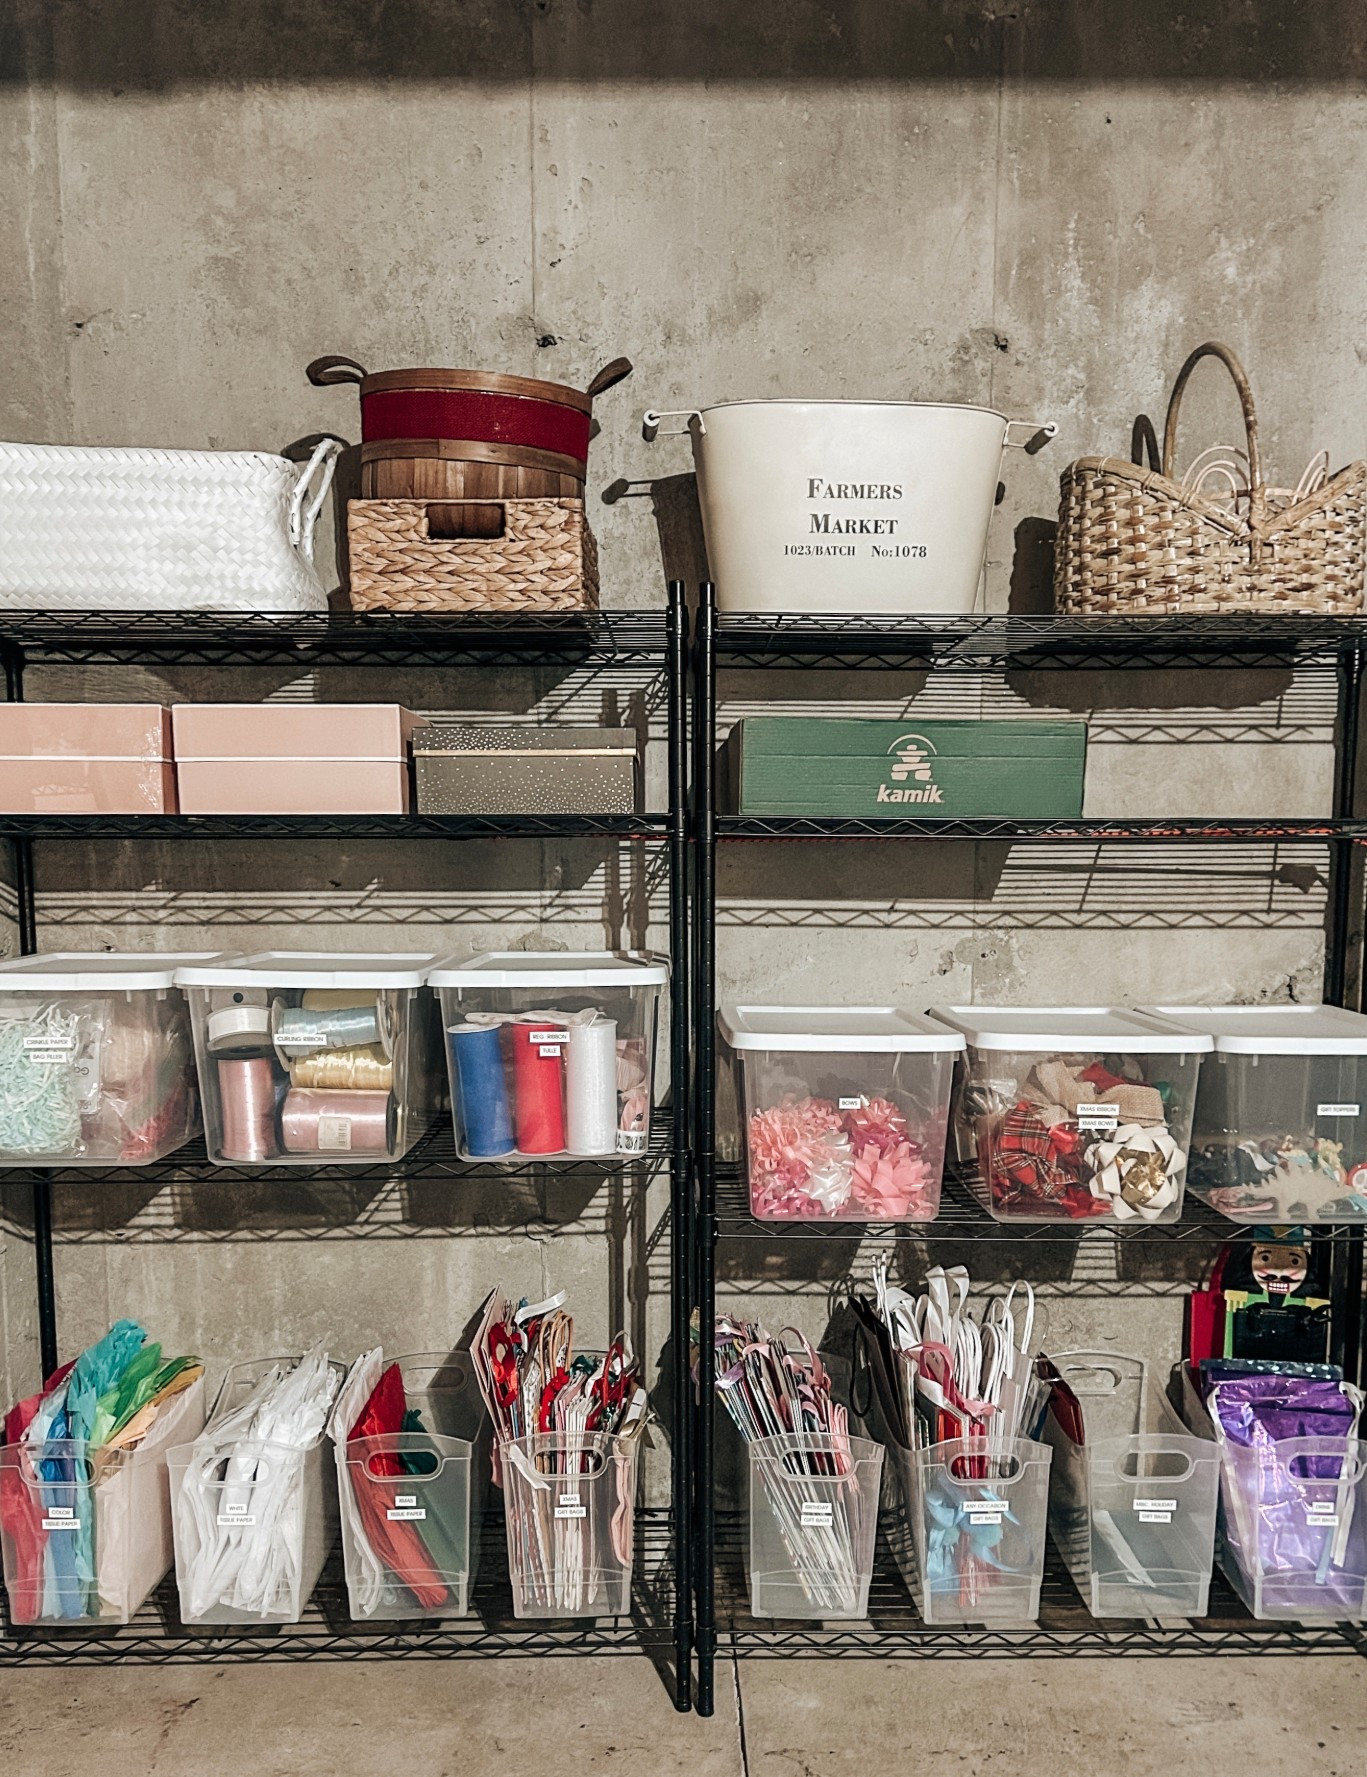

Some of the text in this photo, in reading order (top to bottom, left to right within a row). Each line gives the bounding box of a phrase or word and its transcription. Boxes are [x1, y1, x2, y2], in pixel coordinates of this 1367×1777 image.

[782, 544, 928, 559] 1023/BATCH No:1078
[876, 784, 944, 803] kamik
